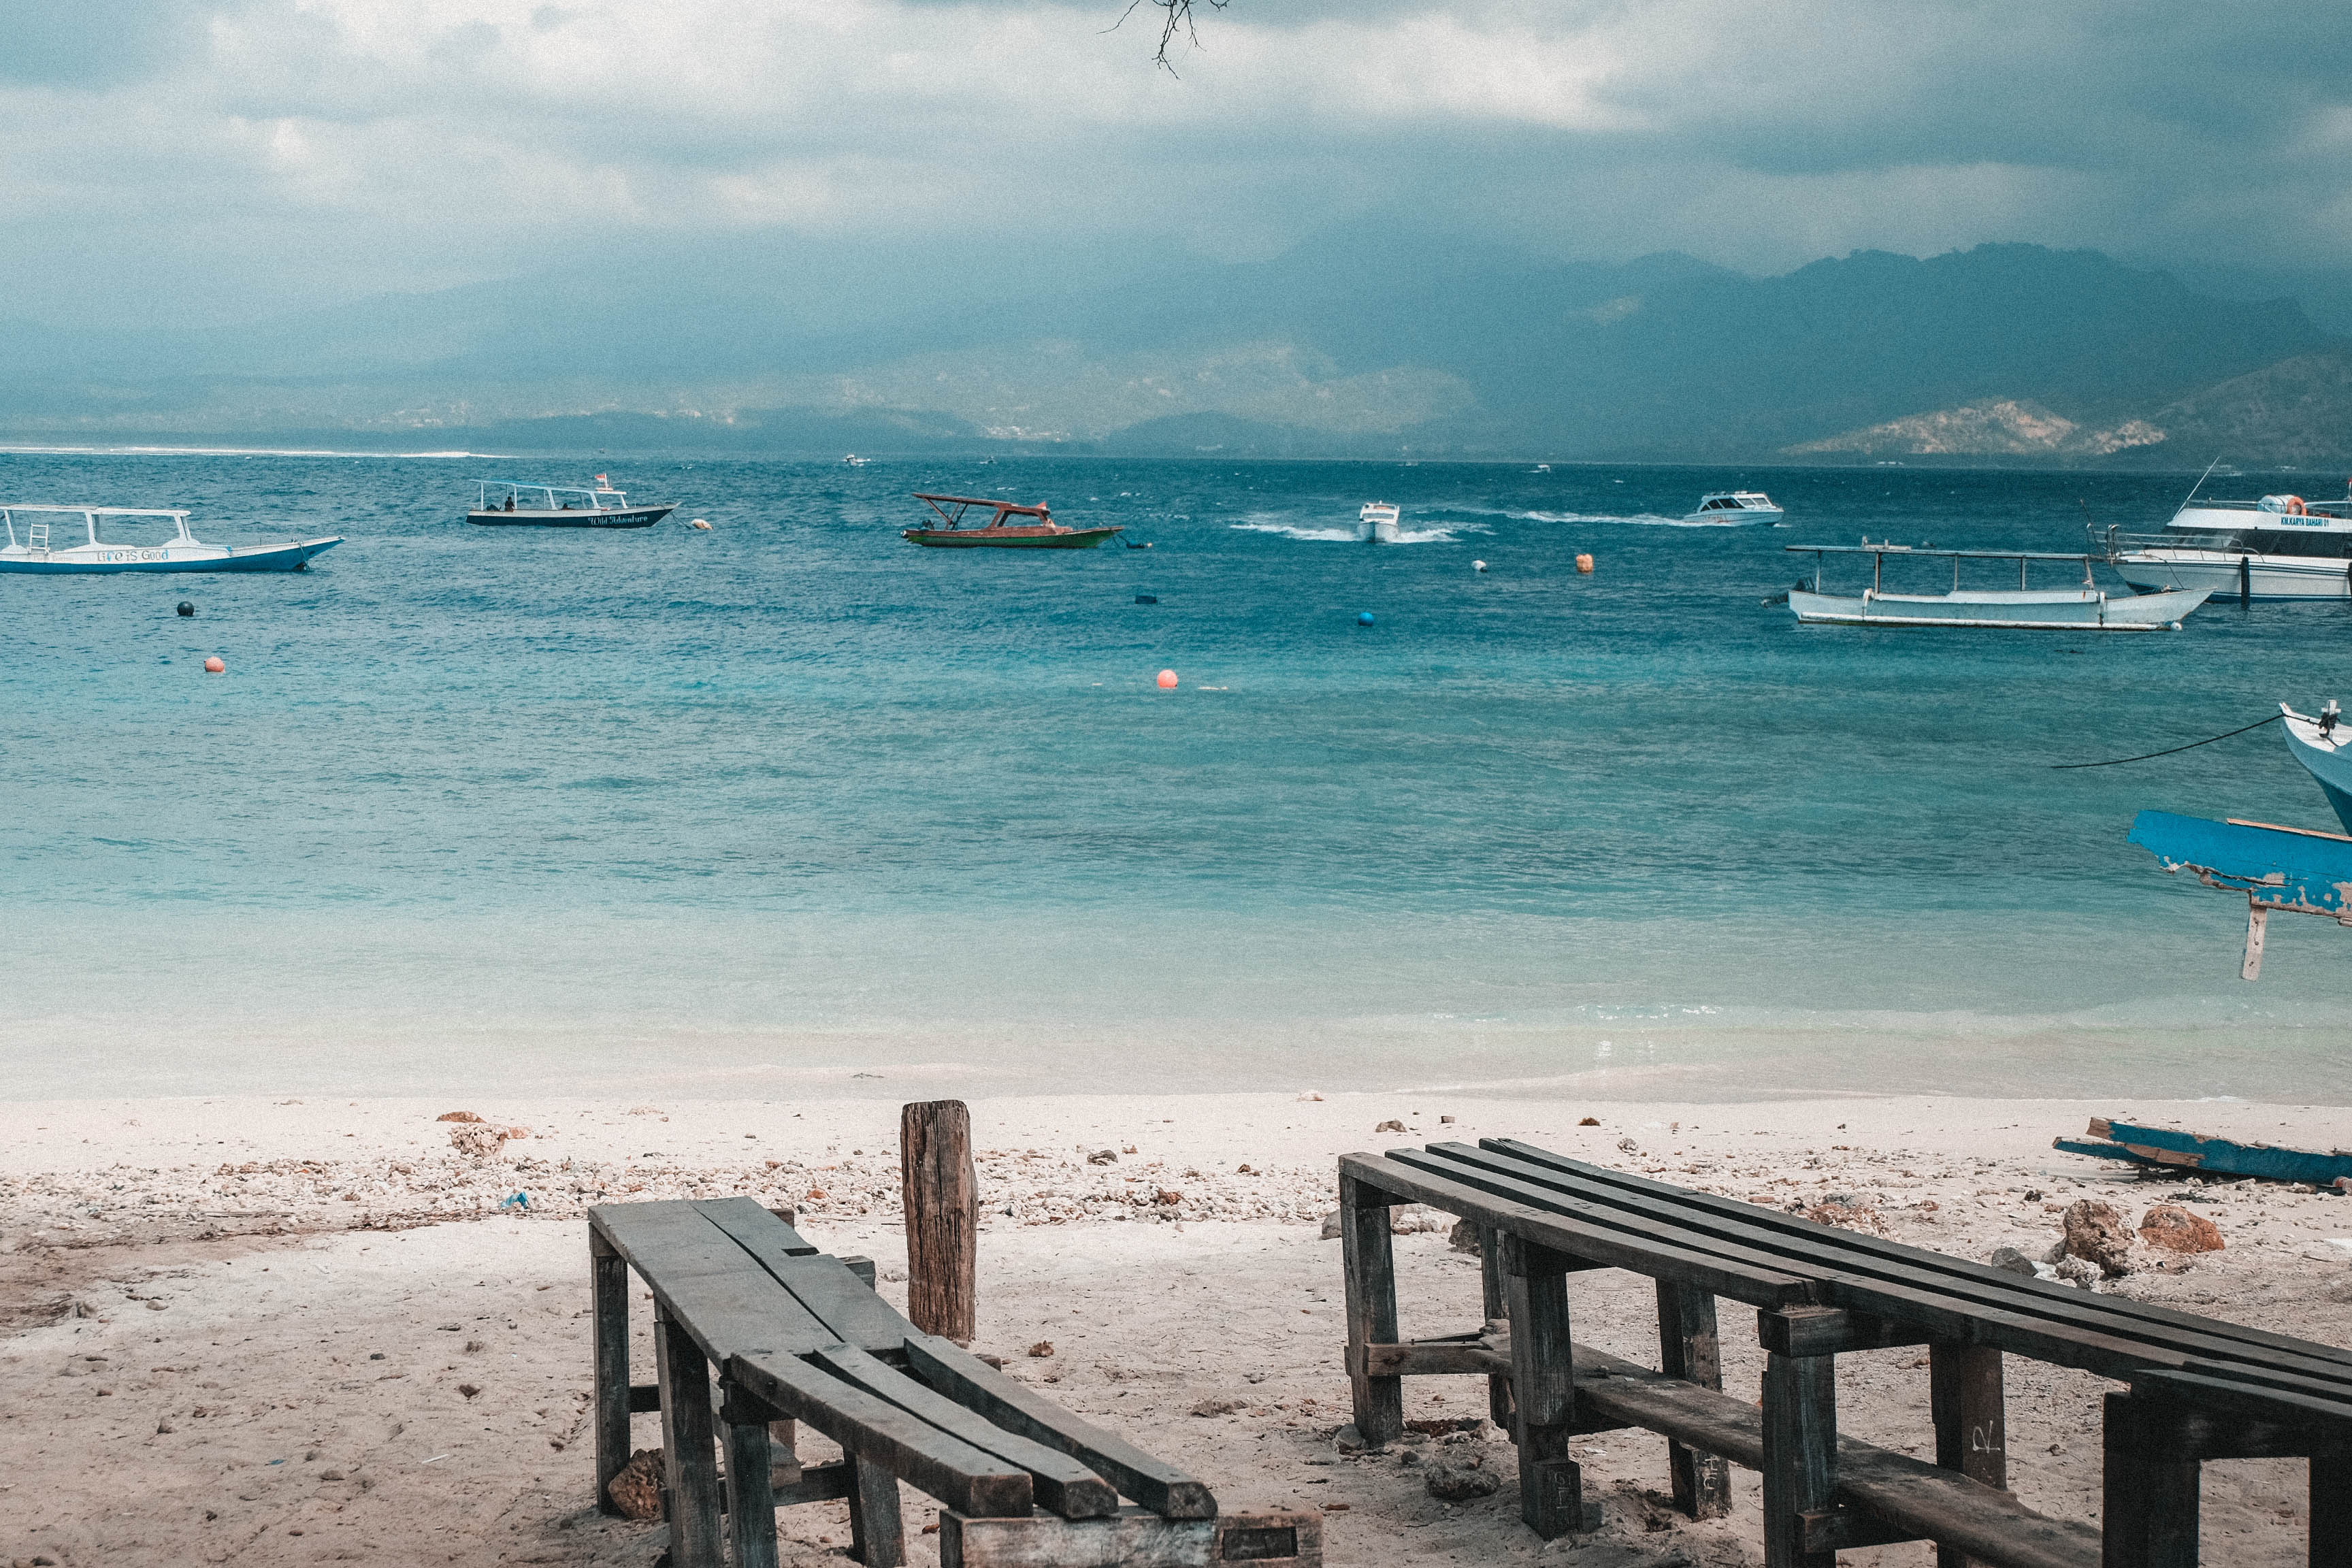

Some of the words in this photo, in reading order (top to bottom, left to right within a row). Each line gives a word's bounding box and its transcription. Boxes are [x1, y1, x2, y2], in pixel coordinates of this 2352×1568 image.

[588, 517, 607, 525] Wild
[609, 514, 647, 523] Adventure
[2306, 518, 2323, 527] BAHARI
[97, 551, 122, 561] Life
[142, 549, 168, 560] Good
